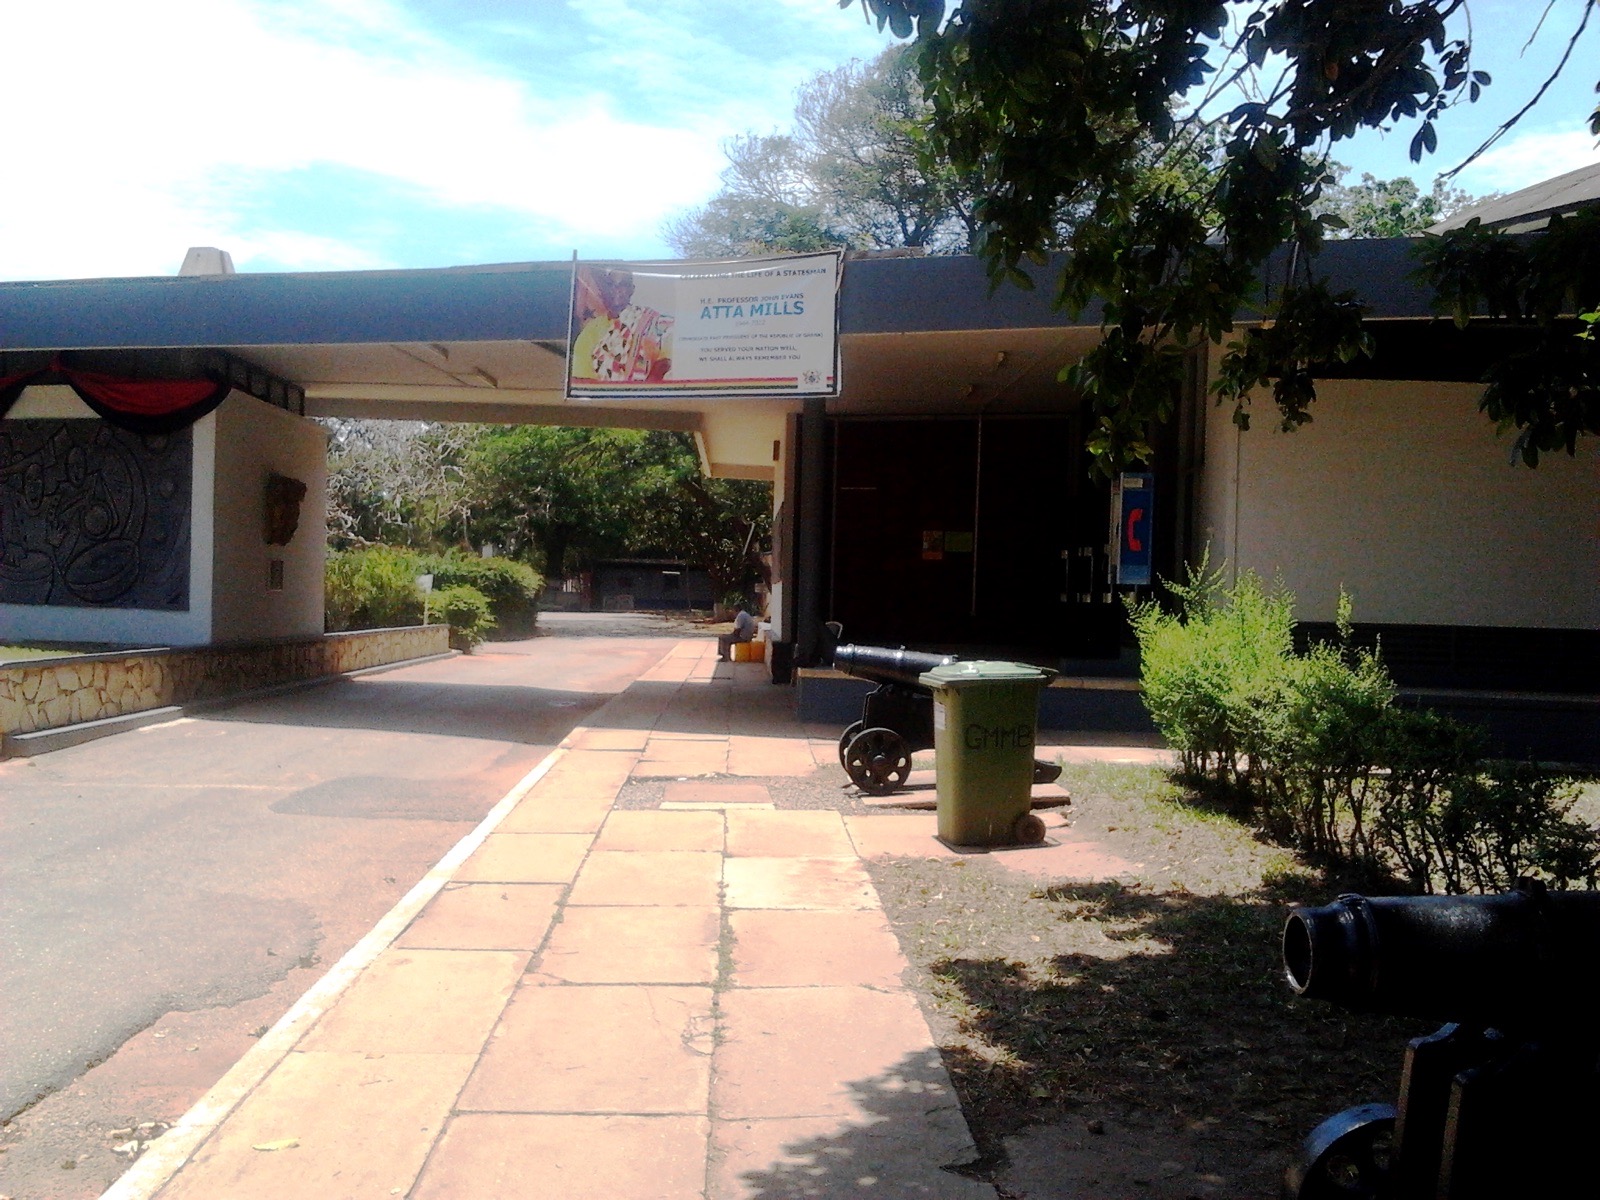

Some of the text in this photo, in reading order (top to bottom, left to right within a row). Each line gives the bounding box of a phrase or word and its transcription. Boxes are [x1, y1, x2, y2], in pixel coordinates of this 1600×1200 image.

[783, 268, 827, 277] STATESMAN
[717, 296, 759, 304] PROFESSOR
[781, 293, 804, 301] EVANS
[700, 301, 805, 320] ATTA MILLS
